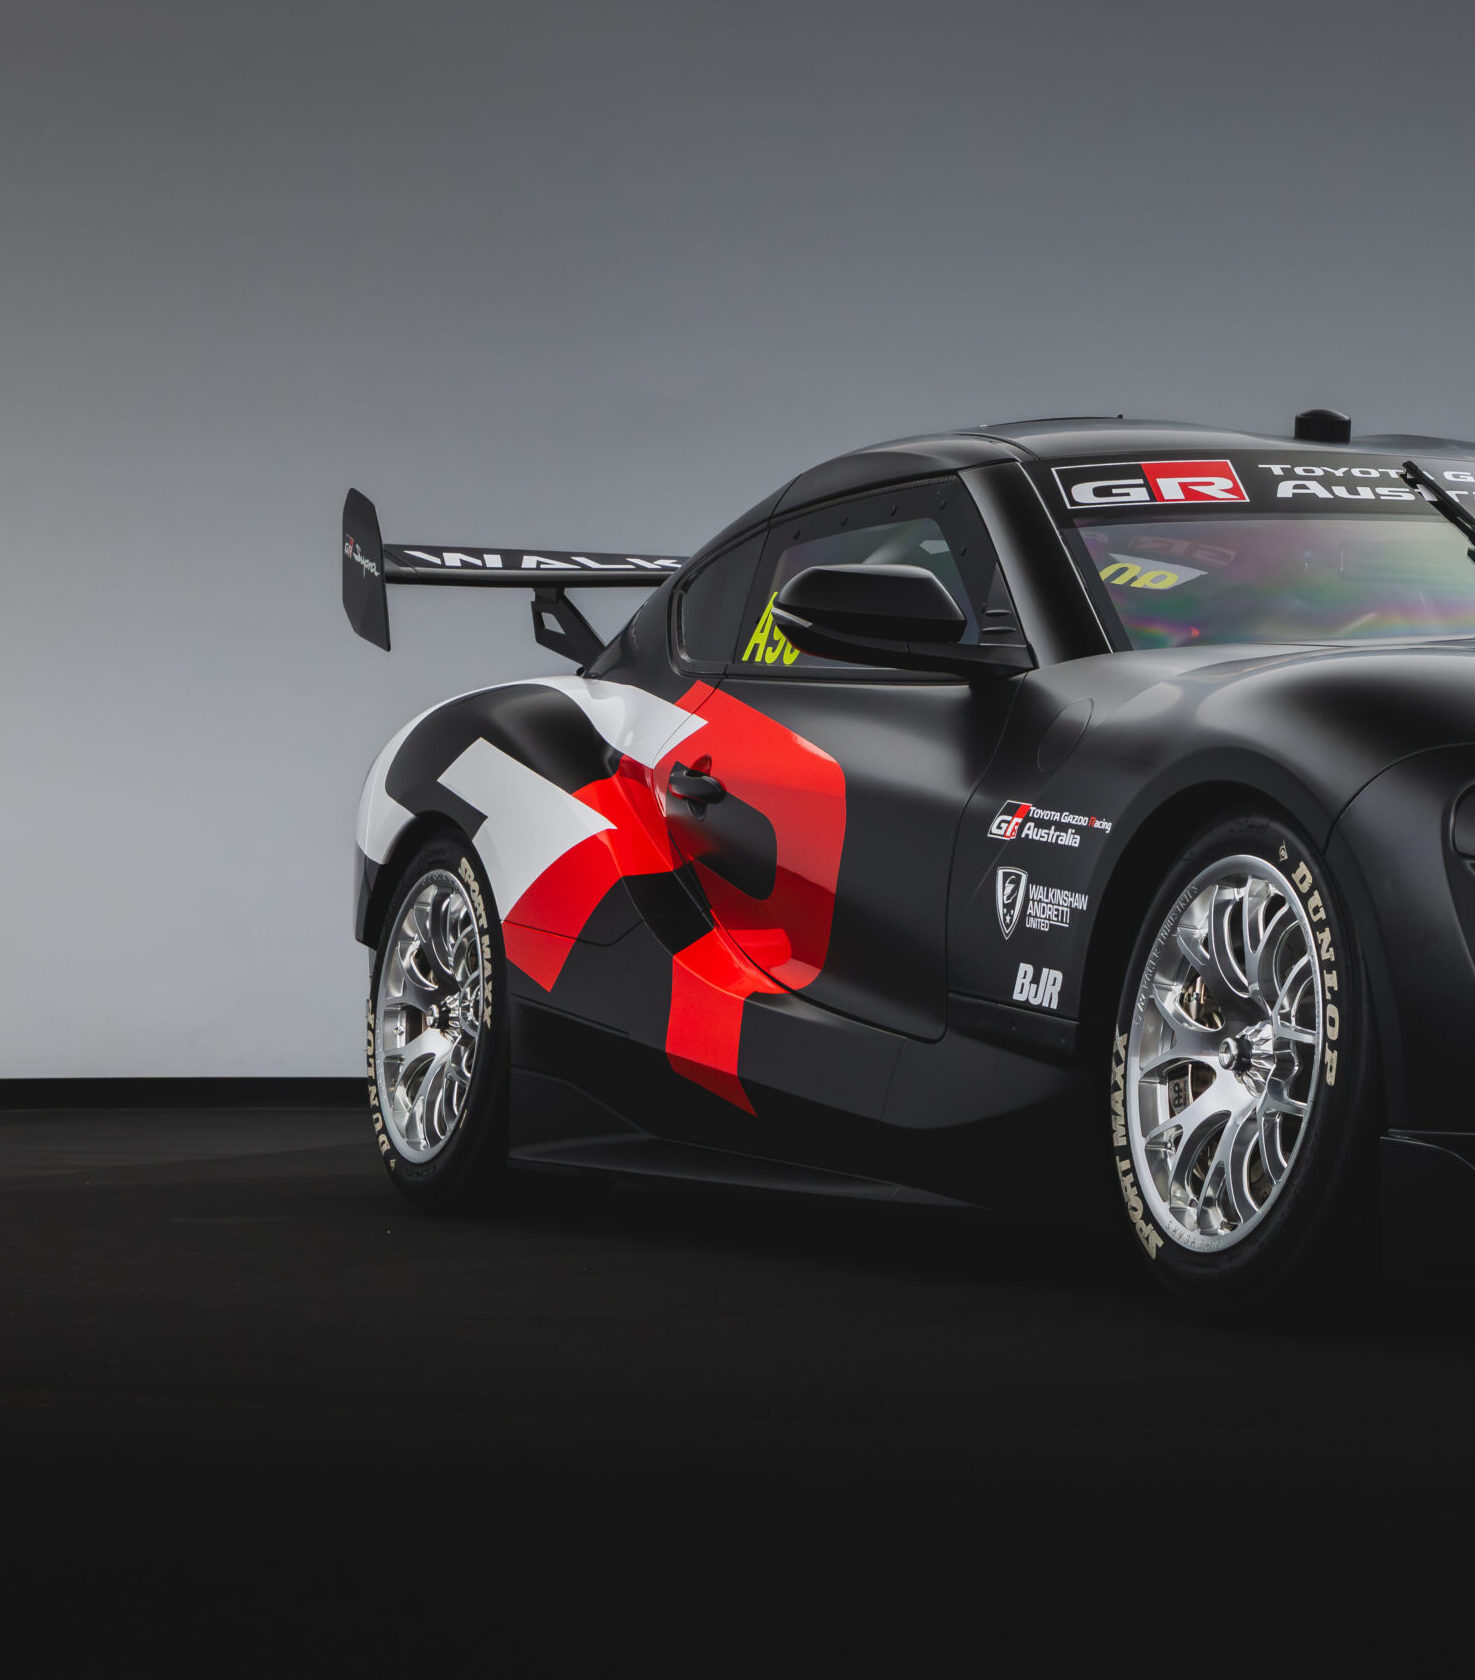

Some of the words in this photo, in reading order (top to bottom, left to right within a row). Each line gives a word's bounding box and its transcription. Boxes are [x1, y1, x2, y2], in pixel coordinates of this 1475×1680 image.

[1072, 476, 1242, 503] GR
[991, 815, 1023, 838] GR
[1029, 807, 1060, 822] TOYOTA
[1061, 811, 1089, 826] GAZOO
[1088, 816, 1112, 833] Racing
[1021, 822, 1081, 847] Australia
[1029, 884, 1089, 911] WALKINSHAW
[1025, 916, 1050, 931] UNITED
[1027, 900, 1071, 924] ANDRETTI
[458, 856, 489, 929] SPORT
[482, 934, 493, 1030] MAXX
[1012, 962, 1063, 1010] BJR
[1292, 861, 1340, 1087] DUNLOP
[366, 999, 393, 1158] DUNLOP
[1110, 1023, 1128, 1147] MAXX
[1115, 1155, 1164, 1261] SPORT
